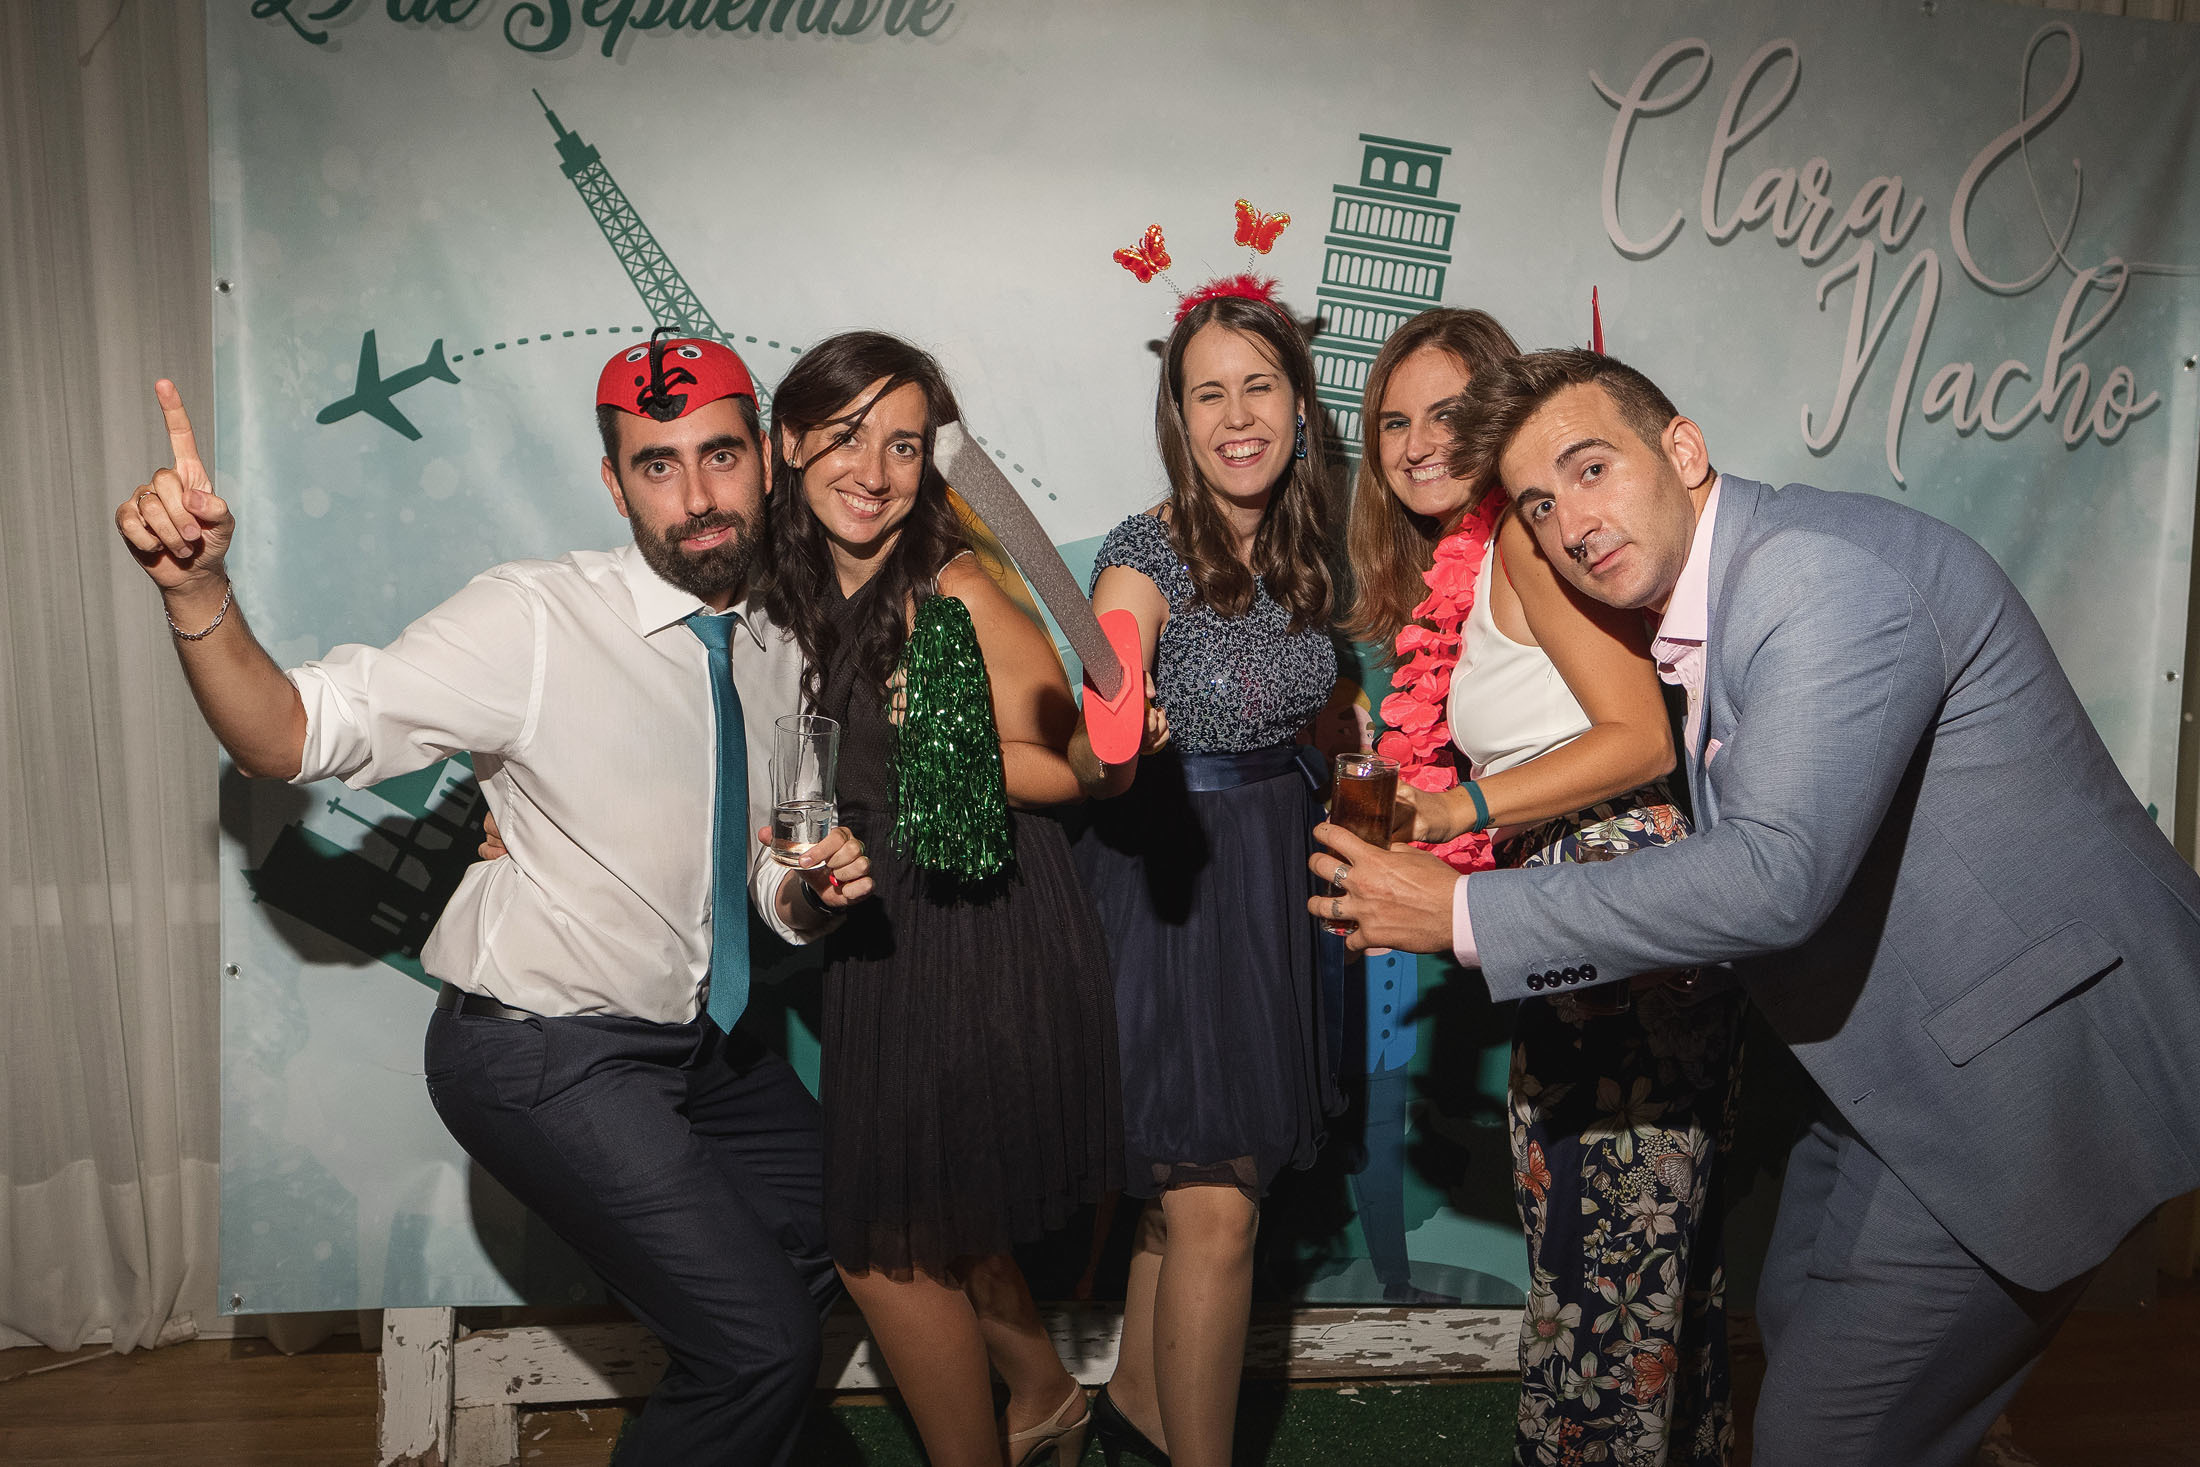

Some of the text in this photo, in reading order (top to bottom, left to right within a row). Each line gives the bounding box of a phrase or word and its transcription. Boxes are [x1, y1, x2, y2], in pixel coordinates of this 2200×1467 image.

[1589, 20, 2130, 292] Clara &
[1801, 241, 2160, 484] Nacho
